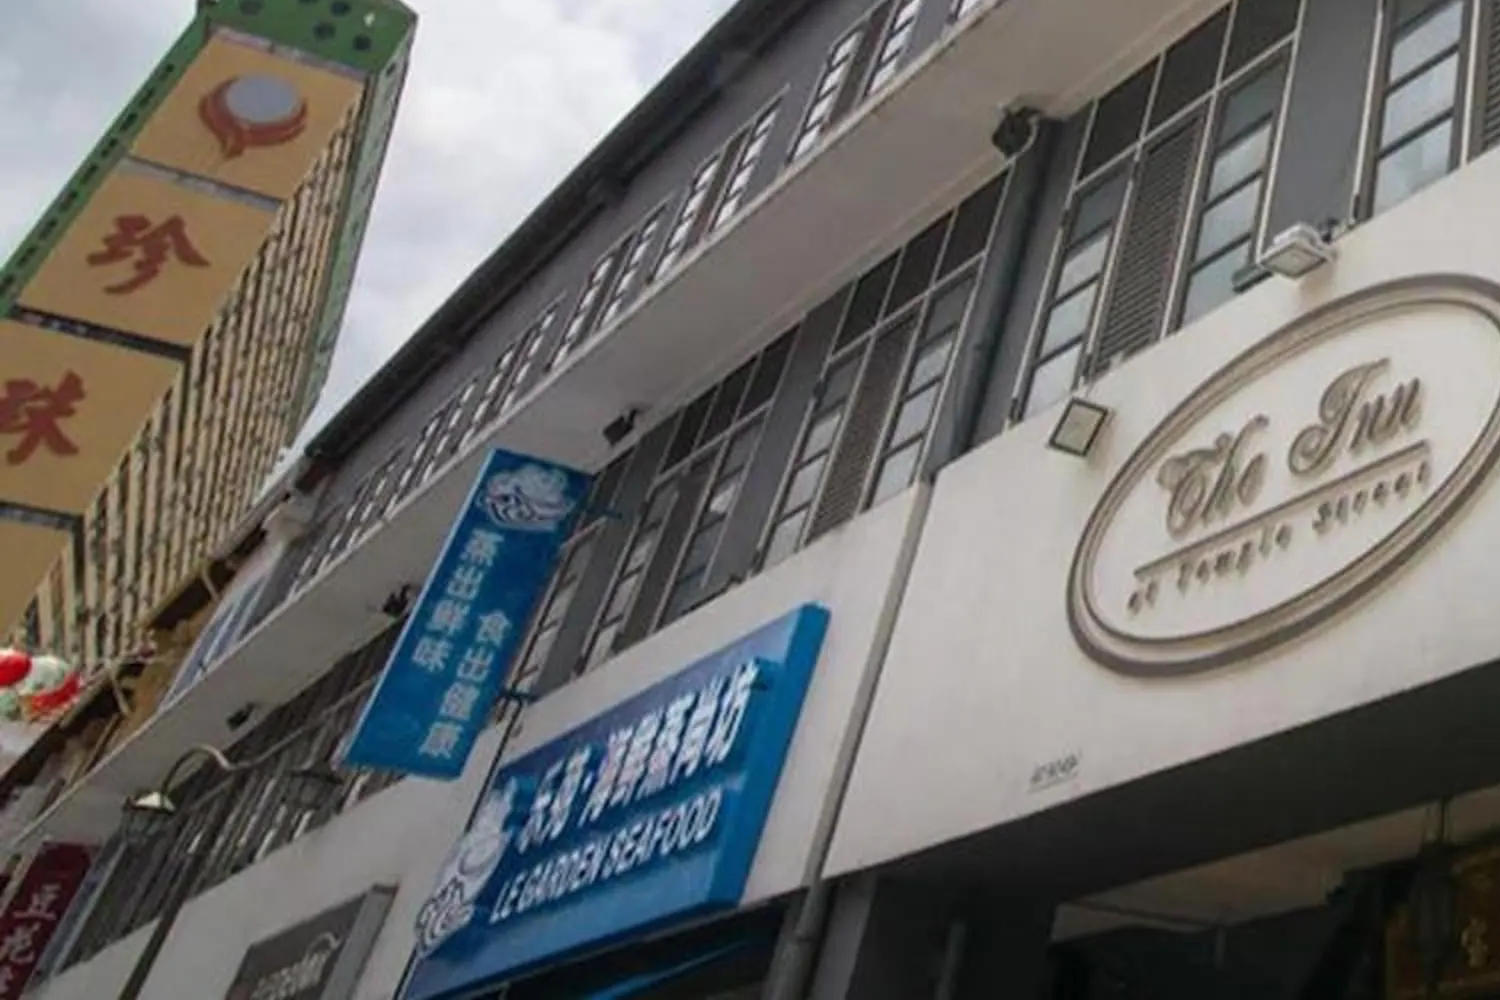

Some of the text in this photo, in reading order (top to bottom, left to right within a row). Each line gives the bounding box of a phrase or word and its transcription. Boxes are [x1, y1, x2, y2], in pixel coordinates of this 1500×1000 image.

[1156, 357, 1422, 541] The Inn
[1177, 522, 1293, 597] Temple
[1311, 460, 1431, 536] Street
[602, 785, 723, 879] SEAFOOD
